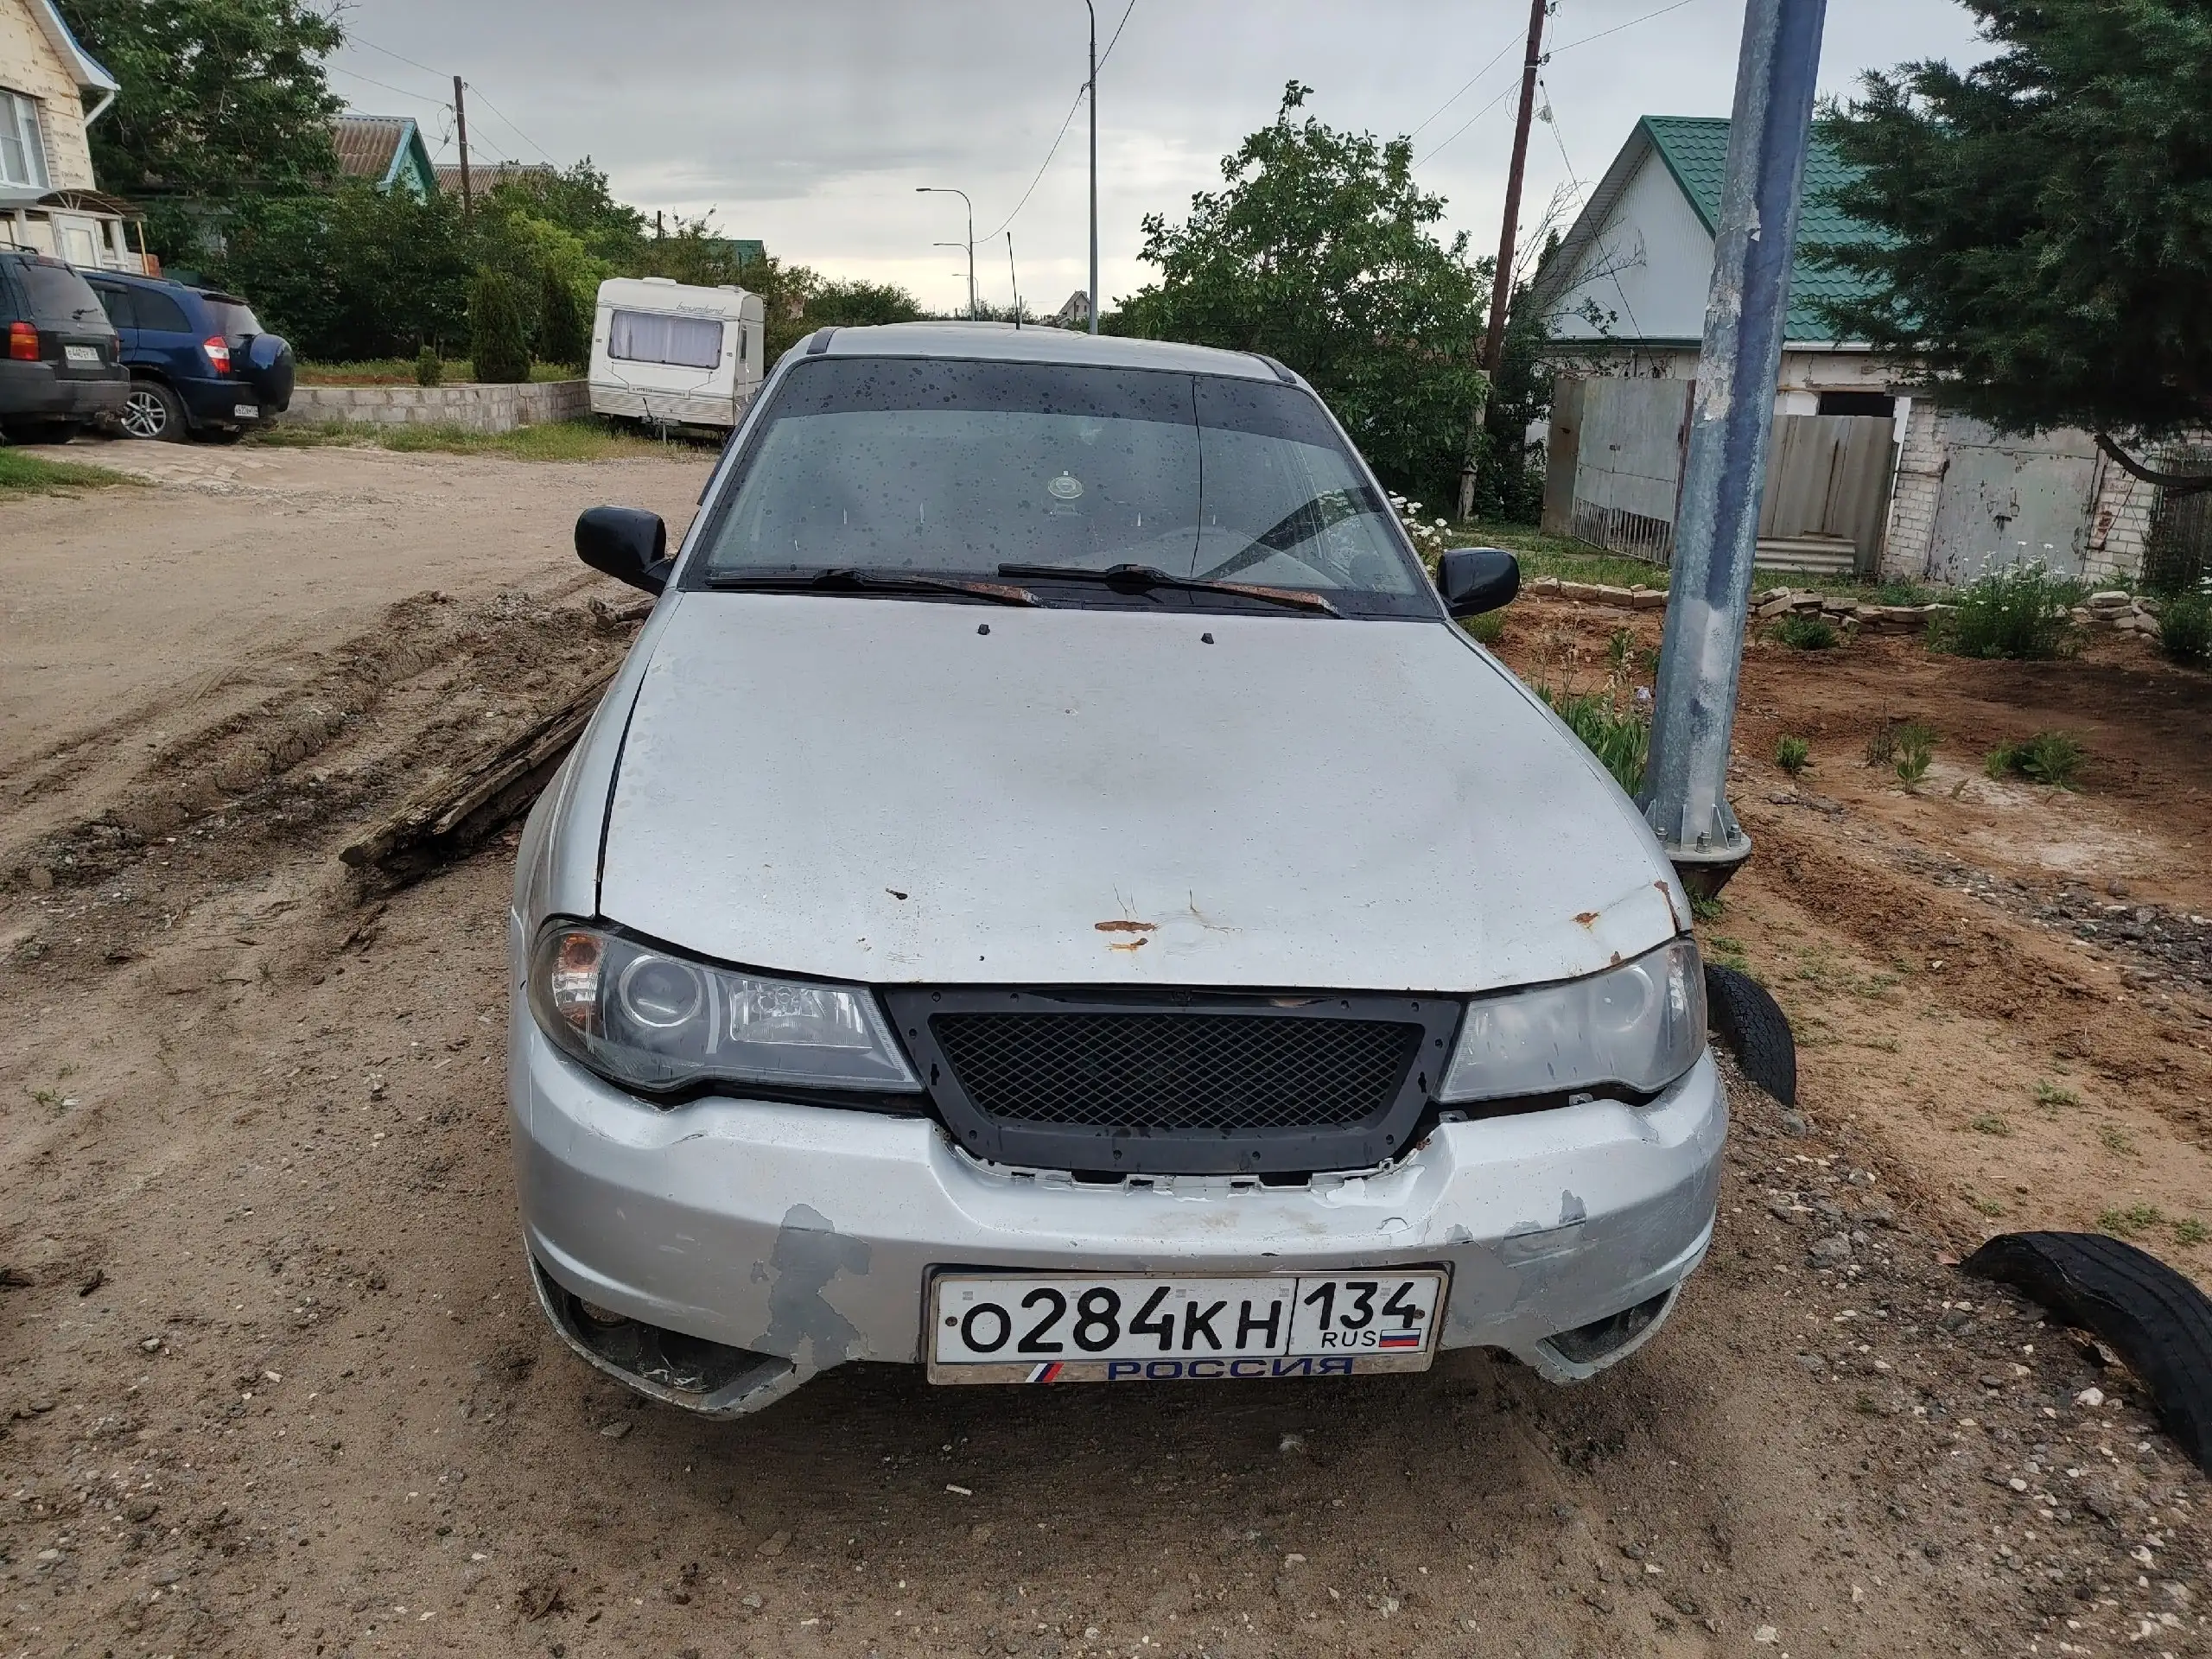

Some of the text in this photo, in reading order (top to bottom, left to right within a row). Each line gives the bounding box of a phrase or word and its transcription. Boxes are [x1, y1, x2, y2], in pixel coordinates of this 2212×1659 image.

[961, 1282, 1416, 1352] О284КН 134
[1321, 1331, 1376, 1348] RUS
[1107, 1357, 1354, 1381] РОССИЯ
